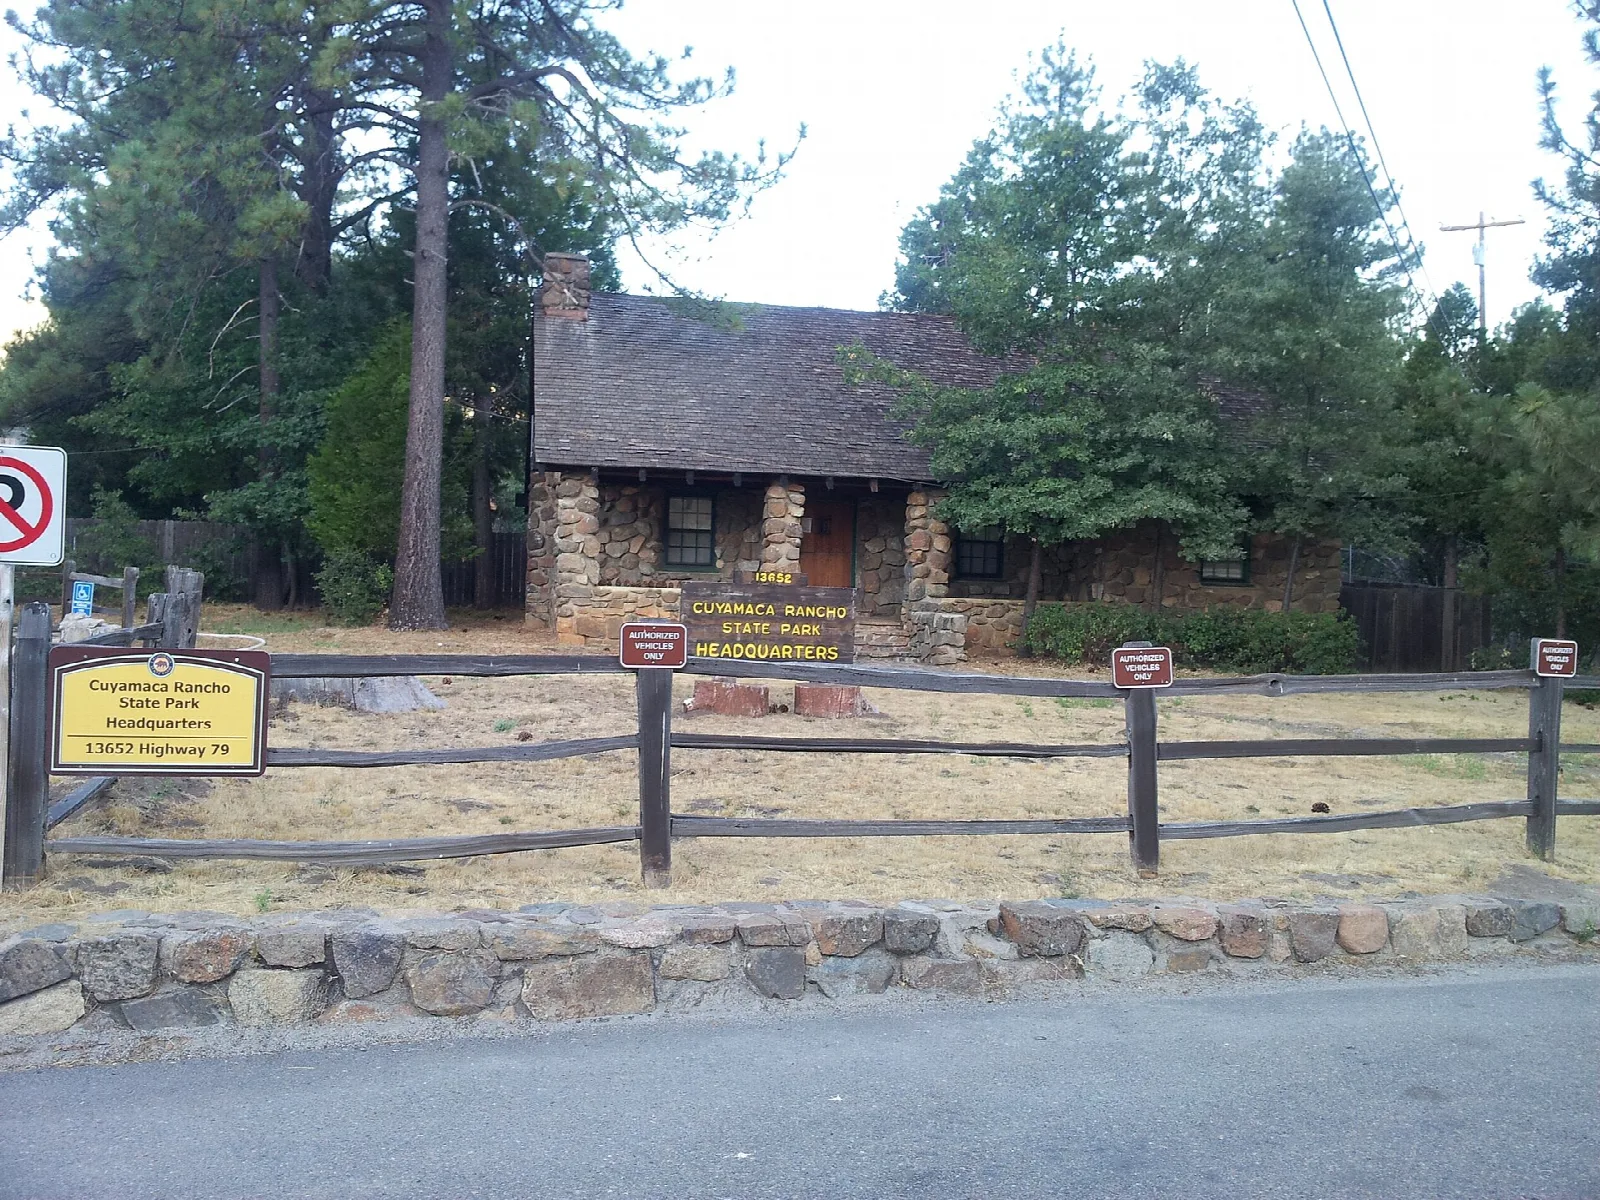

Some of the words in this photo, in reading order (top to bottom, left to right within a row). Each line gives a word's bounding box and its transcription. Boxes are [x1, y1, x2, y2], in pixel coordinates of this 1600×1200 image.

[755, 572, 792, 584] 13652
[692, 602, 775, 616] CUYAMACA
[784, 605, 847, 619] RANCHO
[722, 622, 770, 635] STATE
[780, 623, 821, 636] PARK
[629, 631, 680, 640] AUTHORIZED
[635, 642, 674, 650] VEHICLES
[696, 643, 838, 660] HEADQUARTERS
[643, 652, 664, 660] ONLY
[1119, 654, 1165, 663] AUTHORIZED
[1125, 664, 1160, 672] VEHICLES
[88, 679, 169, 693] Cuyamaca
[174, 682, 231, 694] Rancho
[119, 697, 160, 709] State
[165, 698, 200, 709] Park
[106, 717, 212, 732] Headquarters
[85, 742, 134, 754] 13652
[139, 743, 206, 758] Highway
[211, 744, 230, 755] 79
